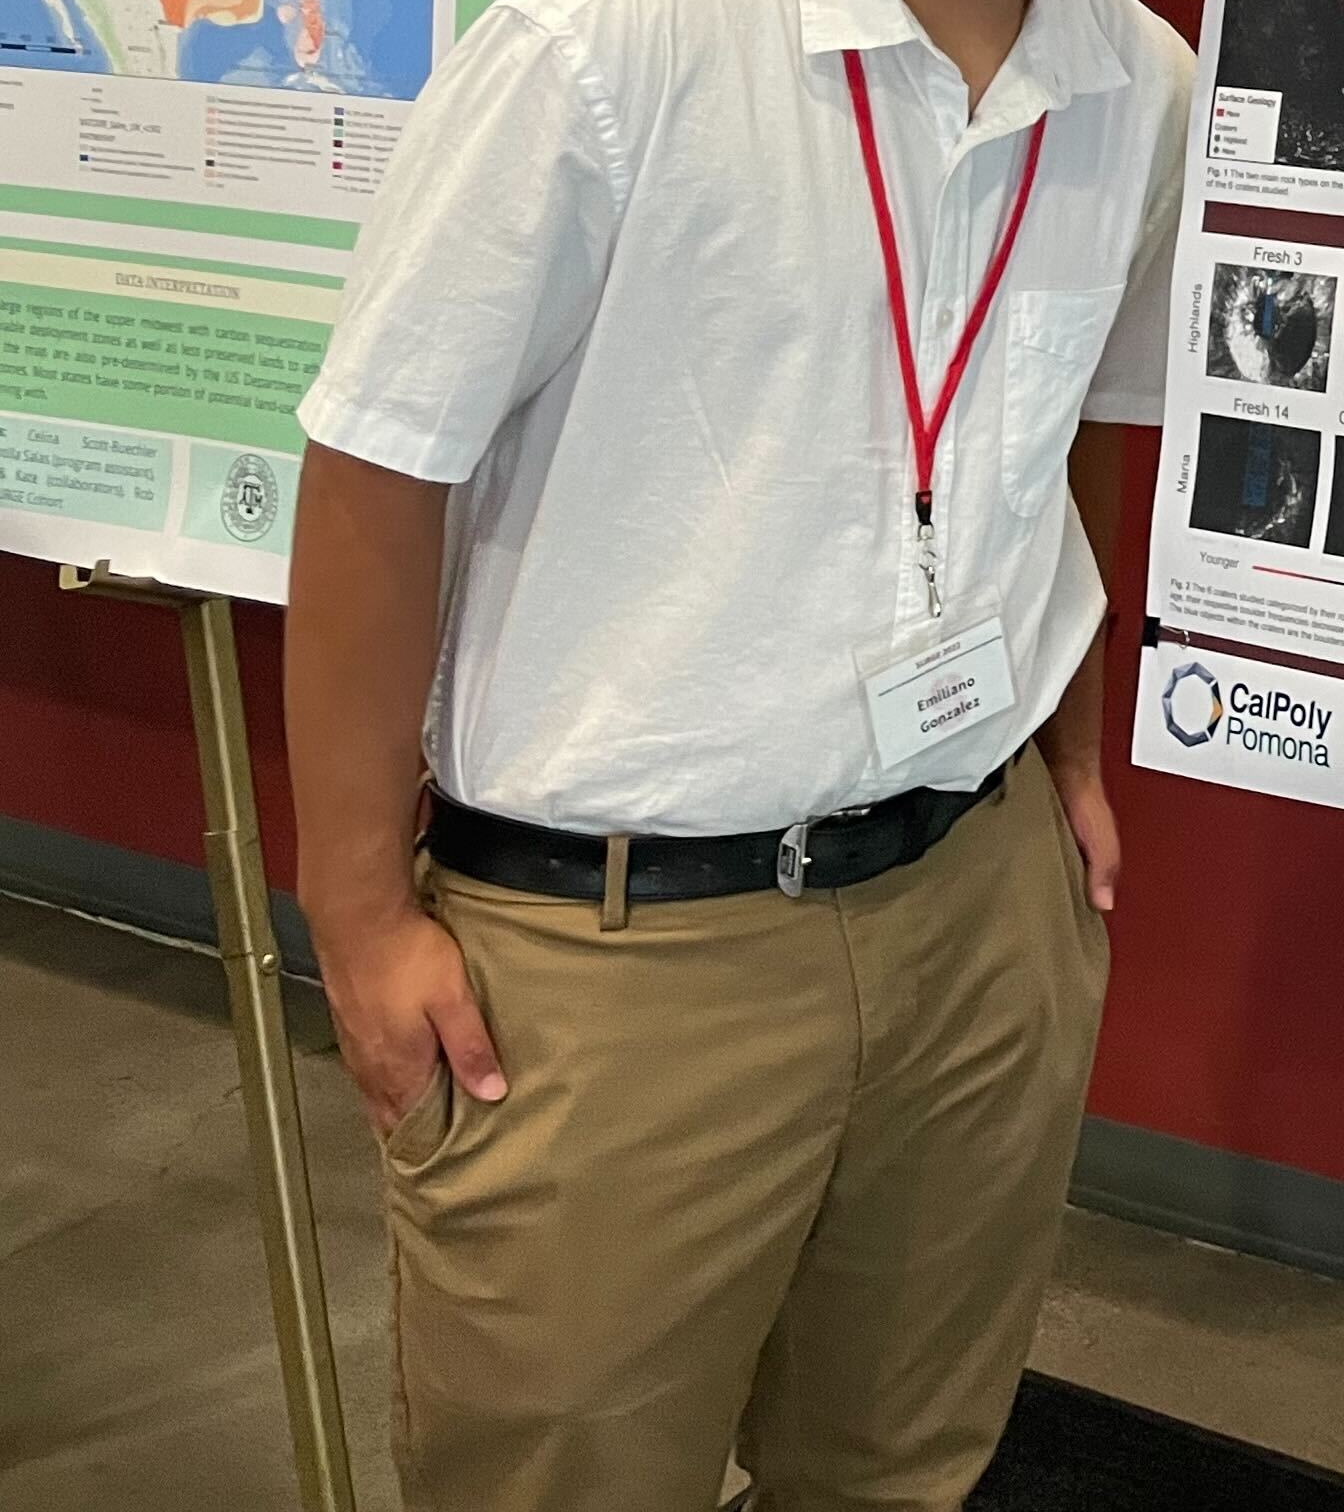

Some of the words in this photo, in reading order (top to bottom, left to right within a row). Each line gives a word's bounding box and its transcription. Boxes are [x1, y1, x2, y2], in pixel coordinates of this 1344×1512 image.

[1253, 246, 1290, 264] Fresh
[1294, 251, 1302, 266] 3
[1188, 282, 1203, 354] Highlands
[1233, 397, 1270, 417] Fresh
[1274, 404, 1288, 419] 14
[1176, 453, 1191, 493] Maria
[1199, 551, 1240, 570] Younger
[918, 677, 975, 712] Emiliano
[920, 698, 980, 733] Gonzalez
[1226, 716, 1330, 768] Pomona
